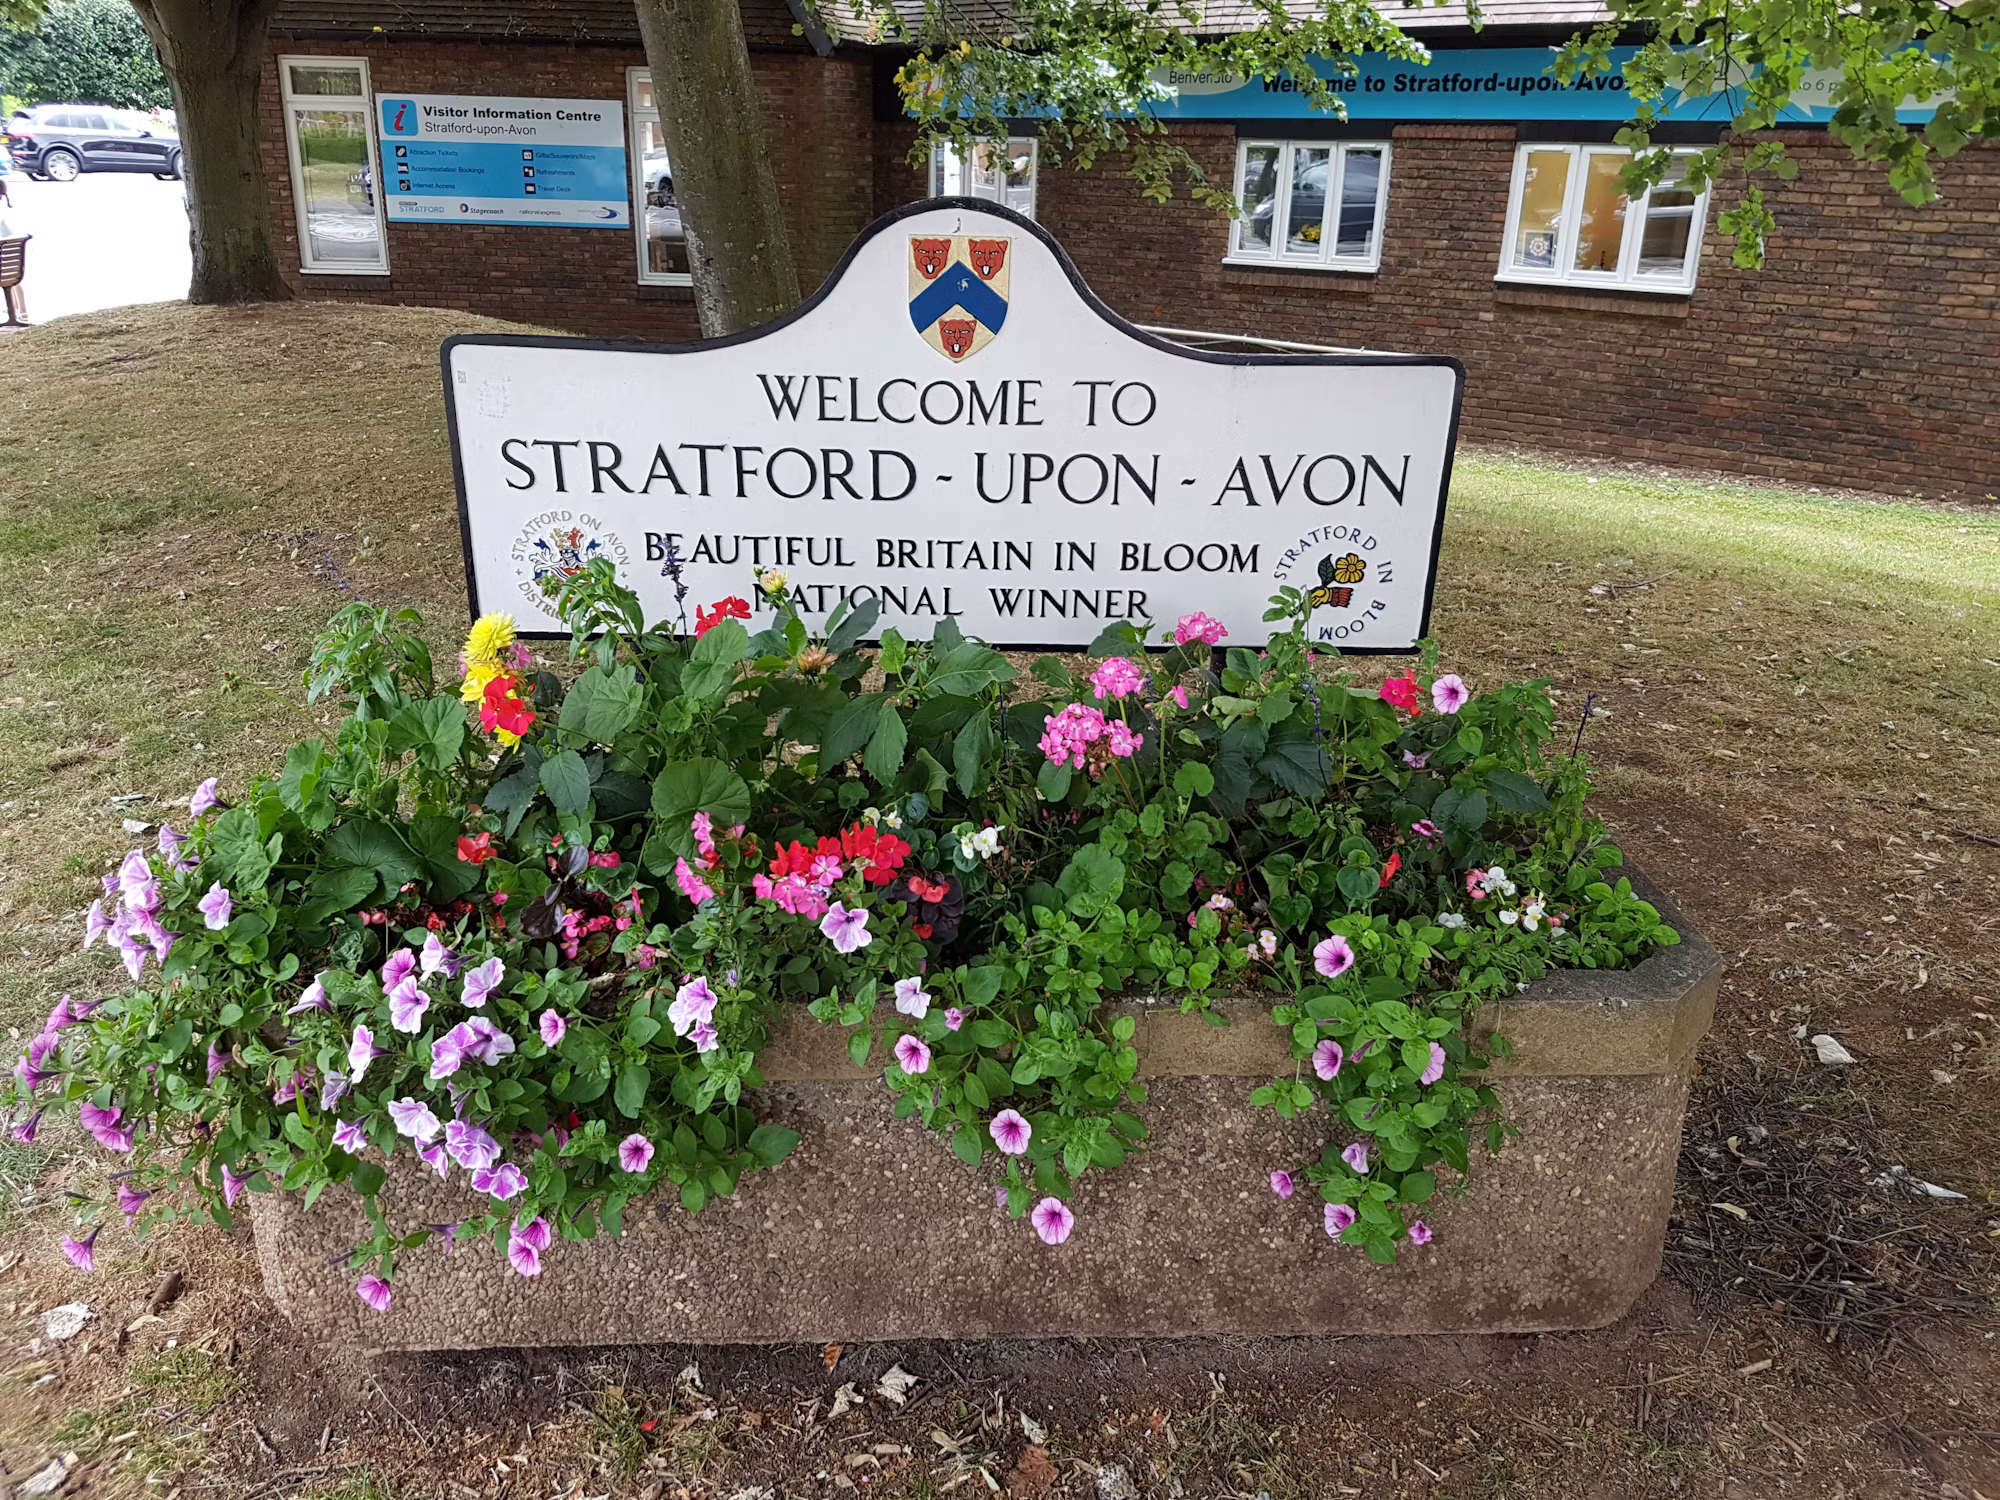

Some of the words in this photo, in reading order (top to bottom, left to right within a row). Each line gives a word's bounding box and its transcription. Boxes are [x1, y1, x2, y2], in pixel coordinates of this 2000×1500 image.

[1262, 74, 1357, 92] Welme
[1363, 74, 1386, 93] to
[1393, 72, 1632, 96] Stratford-upon-Avo
[423, 106, 469, 118] Visitor
[473, 107, 552, 121] Information
[556, 109, 602, 122] Centre
[424, 121, 537, 137] Stratford-upon-Avon
[399, 206, 445, 214] STRATFORD
[469, 207, 504, 215] Stagecoach
[756, 373, 1044, 427] WELCOME
[1072, 380, 1157, 427] TO
[501, 438, 917, 501] STRATFORD
[974, 452, 1161, 506] UPON
[1211, 454, 1411, 507] AVON
[511, 510, 572, 561] STRATFORD
[579, 513, 602, 531] ON
[603, 532, 630, 566] AVON
[644, 532, 856, 567] BEAUTIFUL
[876, 538, 1032, 571] BRITAIN
[1054, 541, 1096, 572] IN
[1119, 542, 1260, 573] BLOOM
[1273, 525, 1378, 580] STRATFORD
[1377, 560, 1393, 584] IN
[518, 581, 572, 620] DISTRI
[988, 588, 1151, 619] WINNER
[1319, 599, 1386, 640] BLOOM
